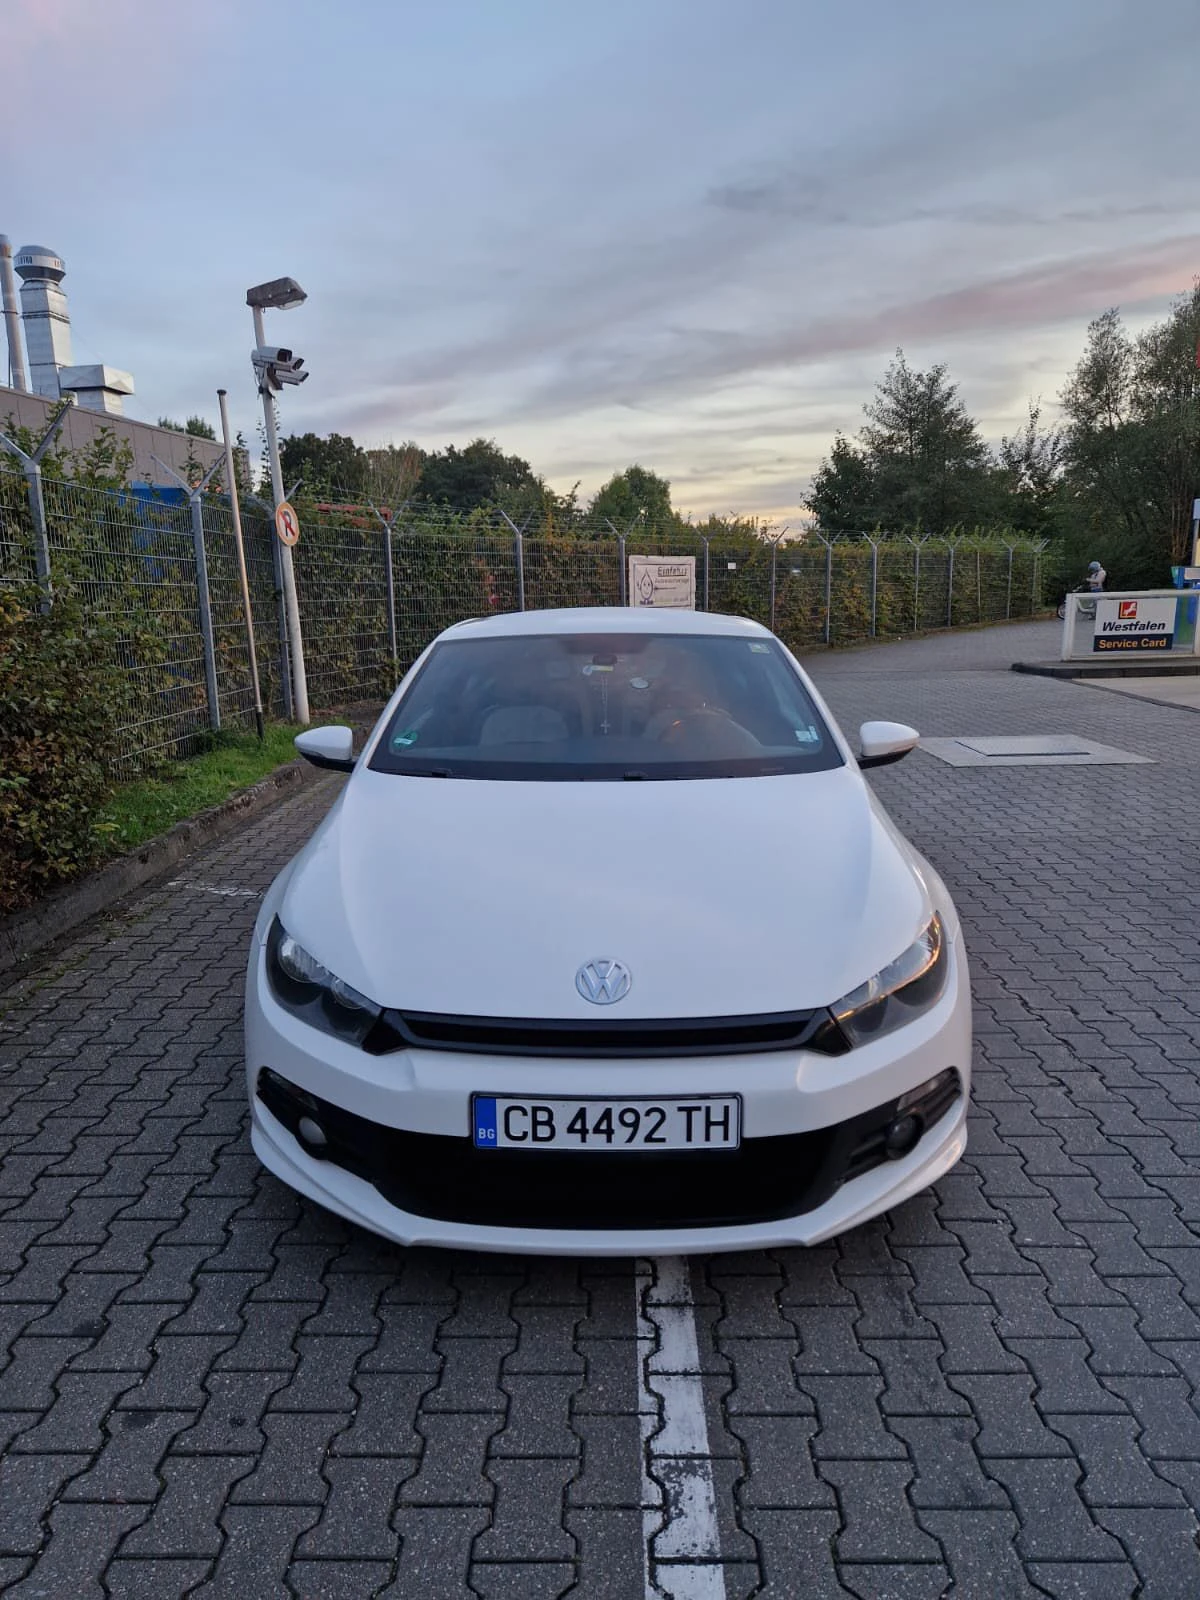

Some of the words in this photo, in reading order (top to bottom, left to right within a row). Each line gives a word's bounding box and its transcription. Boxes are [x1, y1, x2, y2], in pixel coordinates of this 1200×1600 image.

[1102, 620, 1166, 632] Westfalen
[1099, 639, 1138, 649] Service
[1141, 637, 1167, 648] Card
[503, 1105, 557, 1142] CB
[566, 1106, 667, 1144] 4492
[676, 1104, 730, 1143] TH
[478, 1127, 496, 1140] BG
